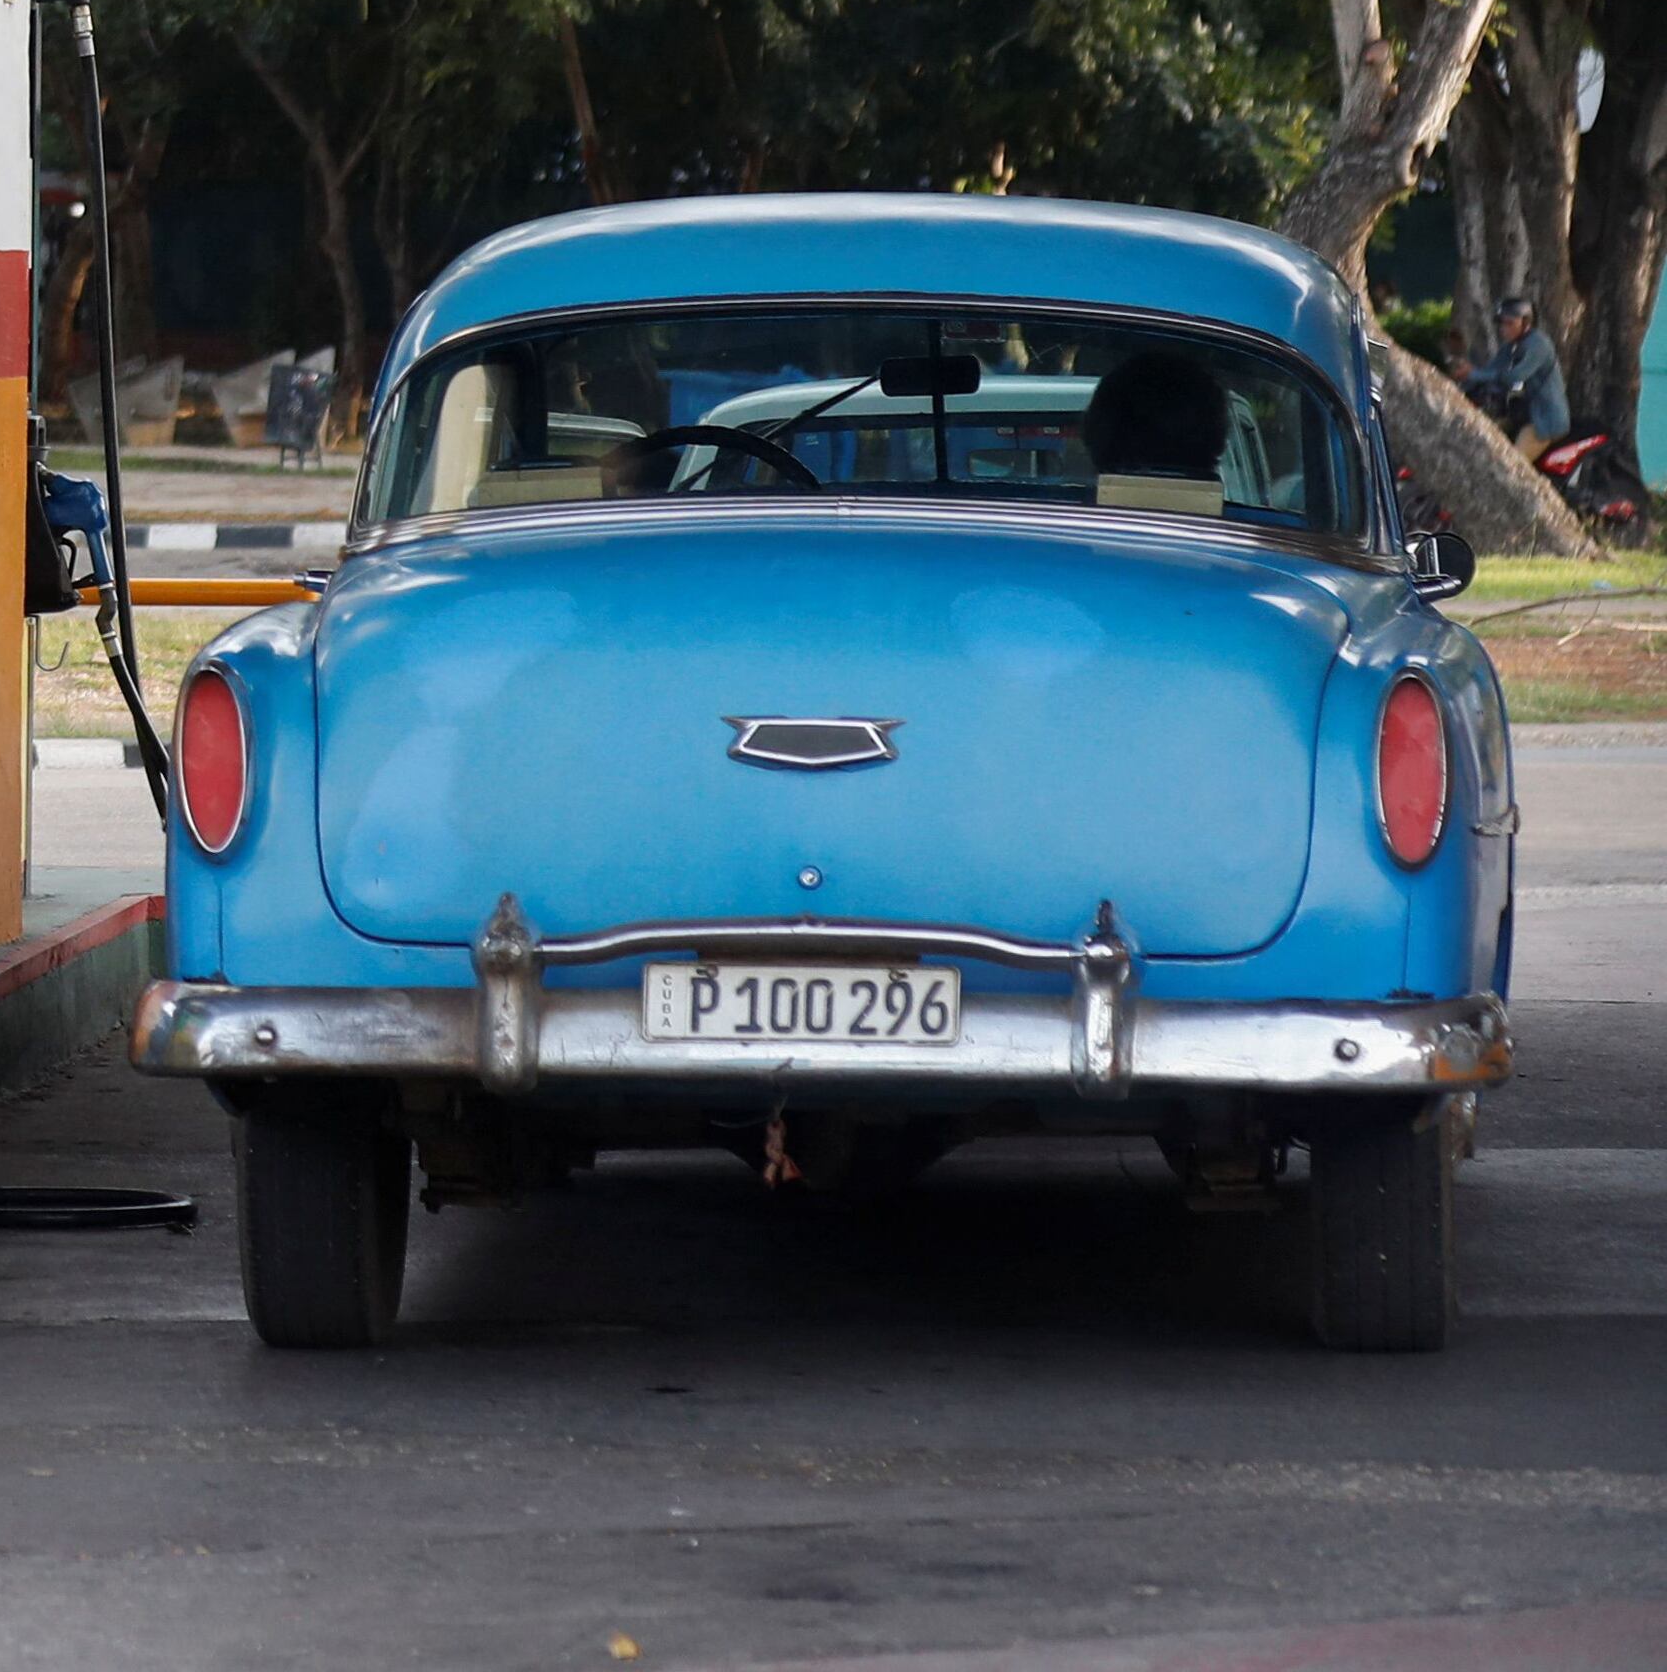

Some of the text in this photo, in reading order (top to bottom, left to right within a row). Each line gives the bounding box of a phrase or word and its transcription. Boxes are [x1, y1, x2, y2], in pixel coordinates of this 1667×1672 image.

[661, 974, 673, 1029] CUBA
[690, 973, 949, 1036] P 100 296
